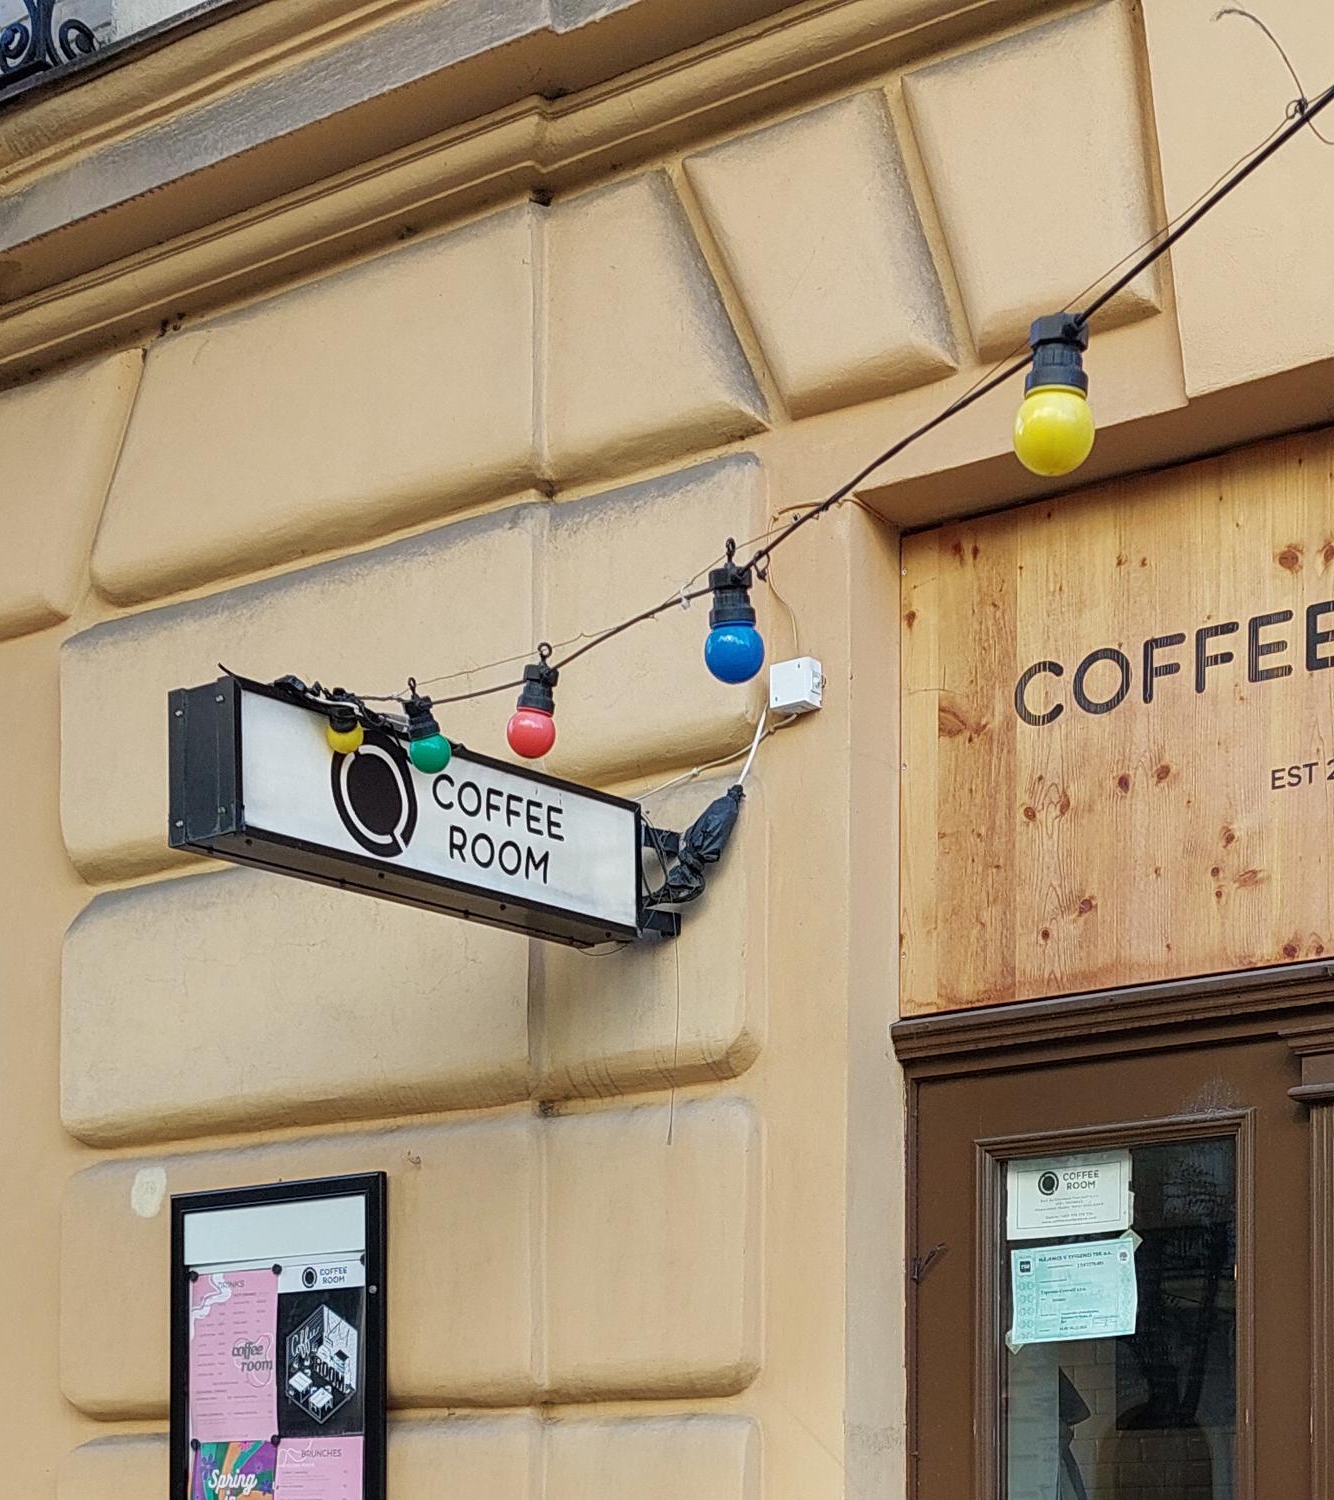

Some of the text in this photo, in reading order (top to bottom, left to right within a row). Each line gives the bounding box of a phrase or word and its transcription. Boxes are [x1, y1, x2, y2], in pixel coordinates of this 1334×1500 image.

[1270, 762, 1319, 790] EST
[432, 774, 565, 842] COFFEE
[449, 825, 549, 885] ROOM
[1062, 1170, 1100, 1181] COFFEE
[1066, 1181, 1096, 1191] ROOM
[319, 1266, 348, 1276] COFFEE
[322, 1276, 346, 1285] ROOM
[232, 1341, 264, 1360] coffee
[240, 1359, 274, 1372] room
[301, 1448, 342, 1458] BRUNCHES
[208, 1469, 258, 1495] Spring
